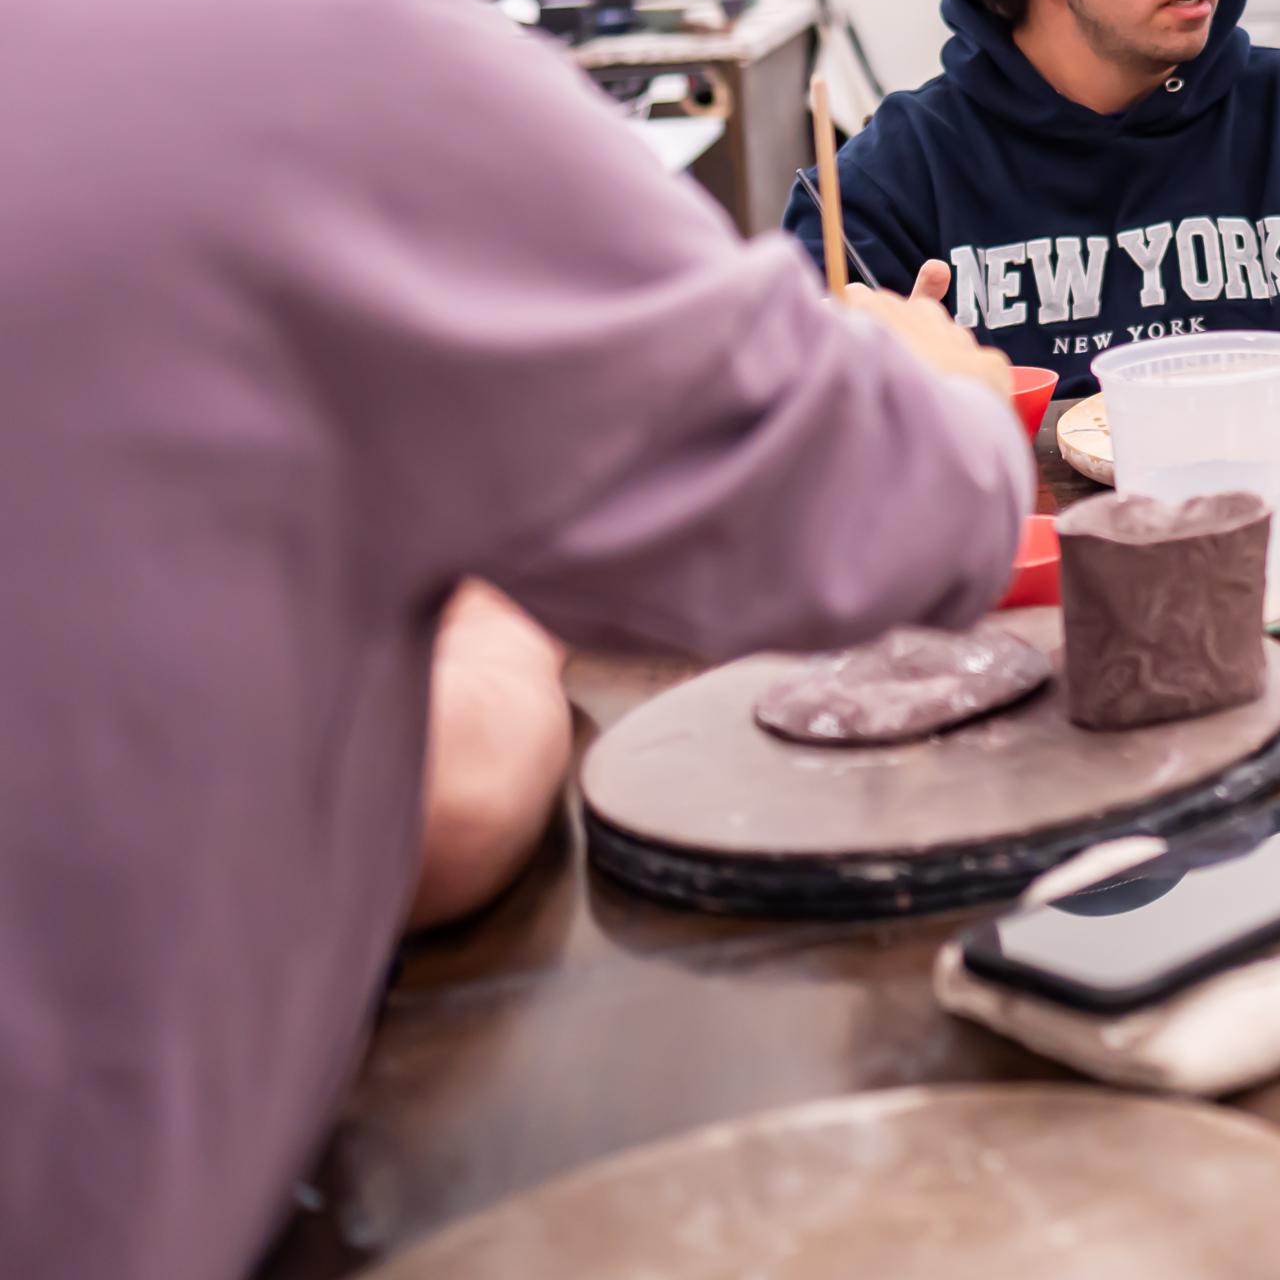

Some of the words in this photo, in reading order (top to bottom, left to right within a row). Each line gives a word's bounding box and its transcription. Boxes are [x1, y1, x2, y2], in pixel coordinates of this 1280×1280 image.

[950, 236, 1109, 330] NEW
[1052, 331, 1113, 355] NEW
[1126, 317, 1208, 344] YORK
